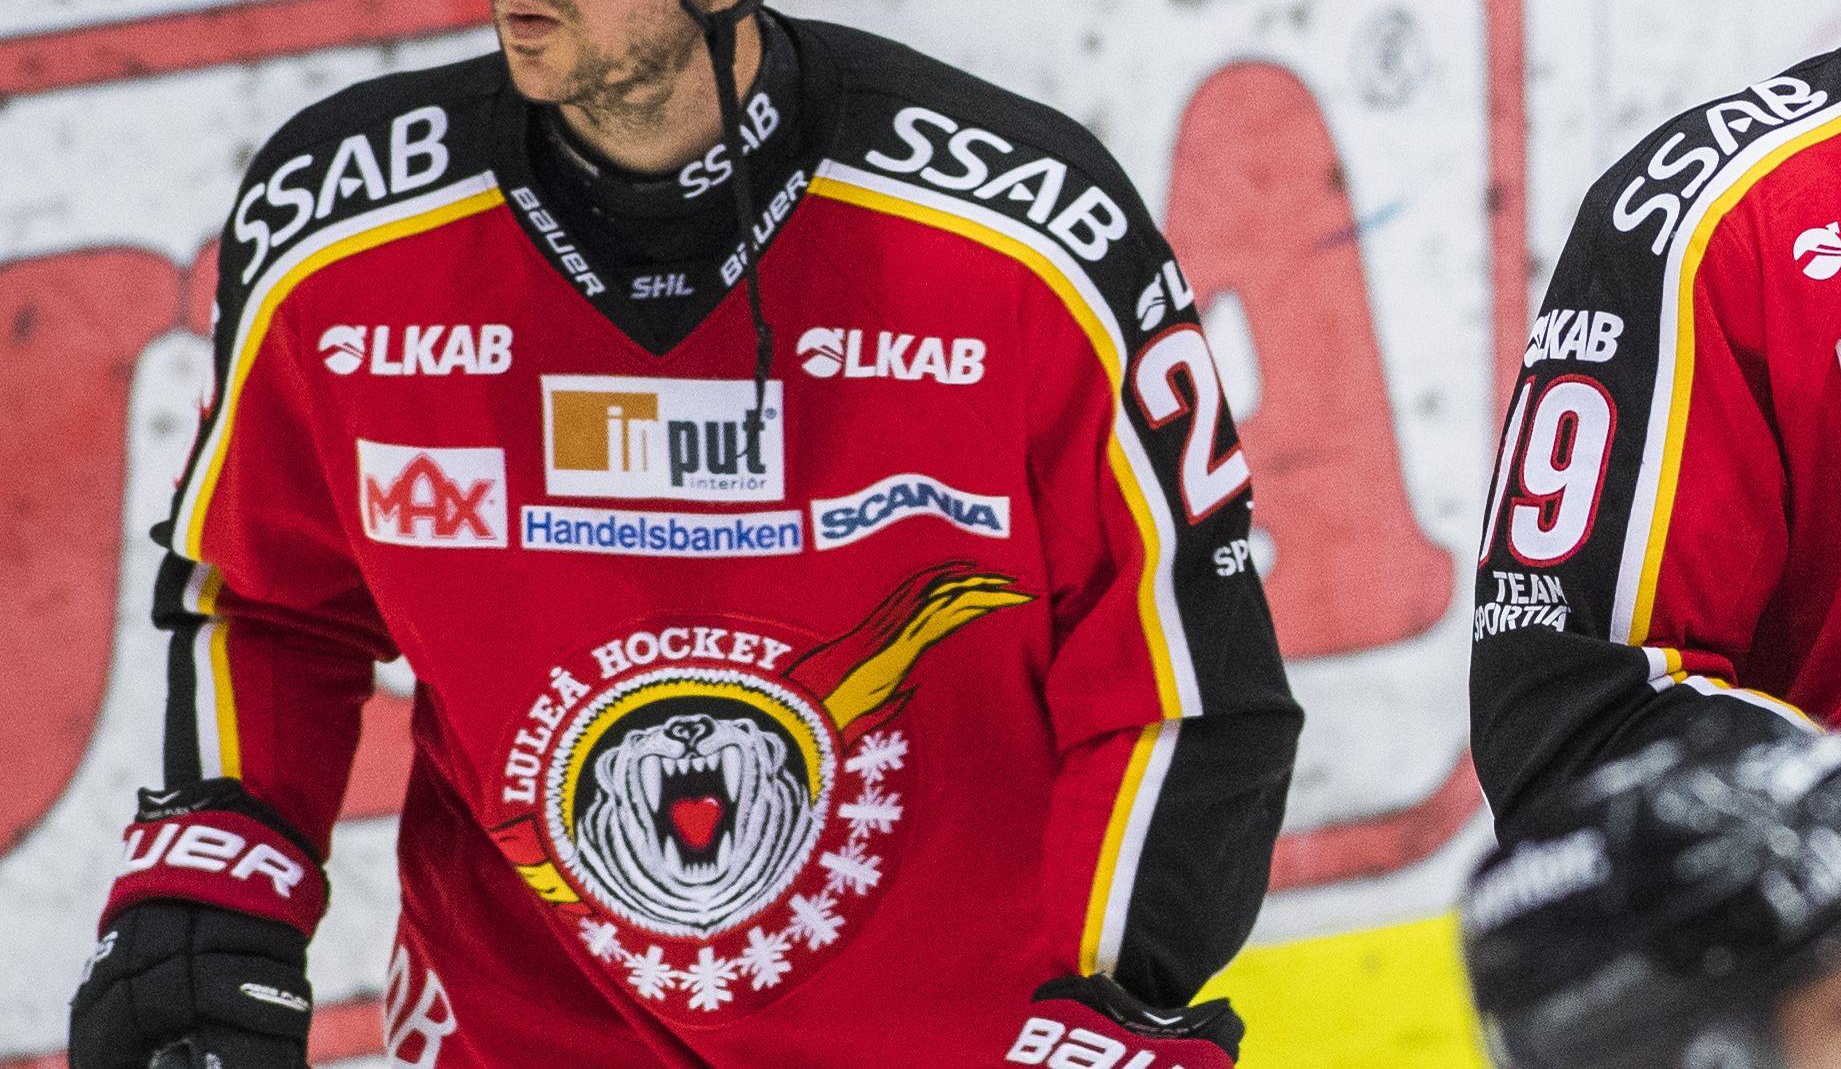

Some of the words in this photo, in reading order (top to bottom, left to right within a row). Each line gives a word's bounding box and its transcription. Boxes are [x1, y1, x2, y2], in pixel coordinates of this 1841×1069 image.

[234, 105, 450, 285] SSAB
[864, 105, 1129, 262] SSAB
[1612, 76, 1829, 256] SSAB
[510, 187, 606, 297] BAUER
[630, 273, 695, 300] SHL
[369, 324, 514, 376] LKAB
[843, 330, 987, 386] LKAB
[607, 405, 767, 488] input
[366, 452, 496, 541] MAX
[526, 509, 800, 553] Handelsbanken
[820, 482, 1004, 541] SCANIA
[501, 665, 591, 805] LULEÅ
[591, 626, 792, 680] HOCKEY
